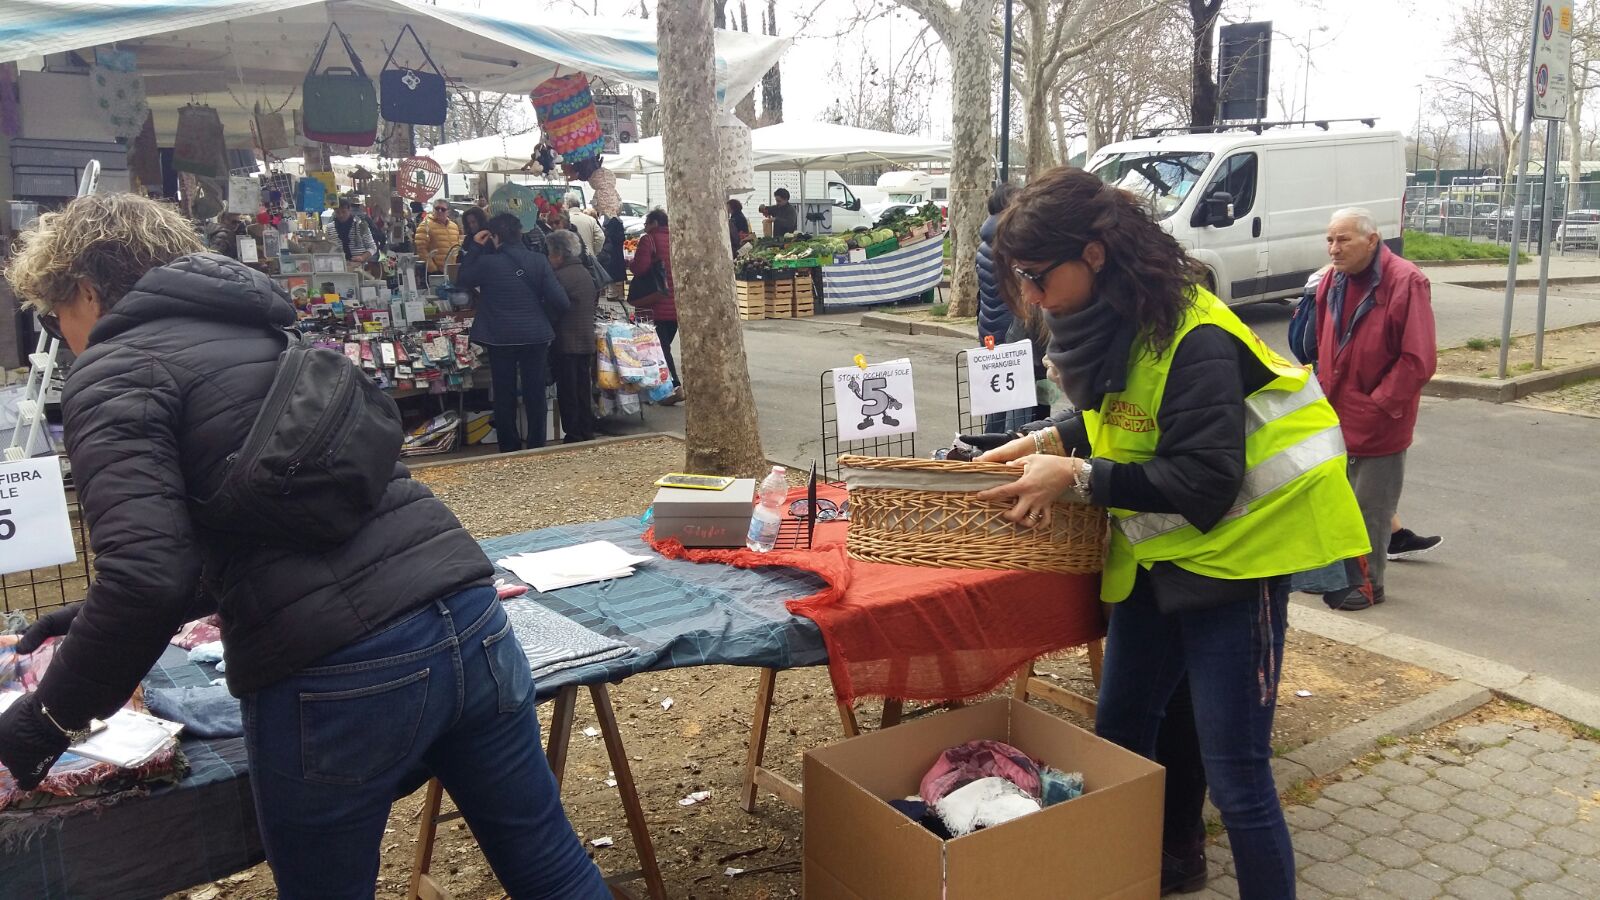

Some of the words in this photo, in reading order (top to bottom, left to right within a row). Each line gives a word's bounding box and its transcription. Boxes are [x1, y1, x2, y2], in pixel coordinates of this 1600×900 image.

[973, 353, 1001, 363] OCCHIALI
[1001, 349, 1027, 359] LETTURA
[981, 359, 1021, 370] INFRANGIBILE
[863, 371, 893, 380] OCCHIALI
[895, 369, 910, 377] SOLE
[990, 374, 1001, 393] €
[1005, 372, 1015, 391] 5
